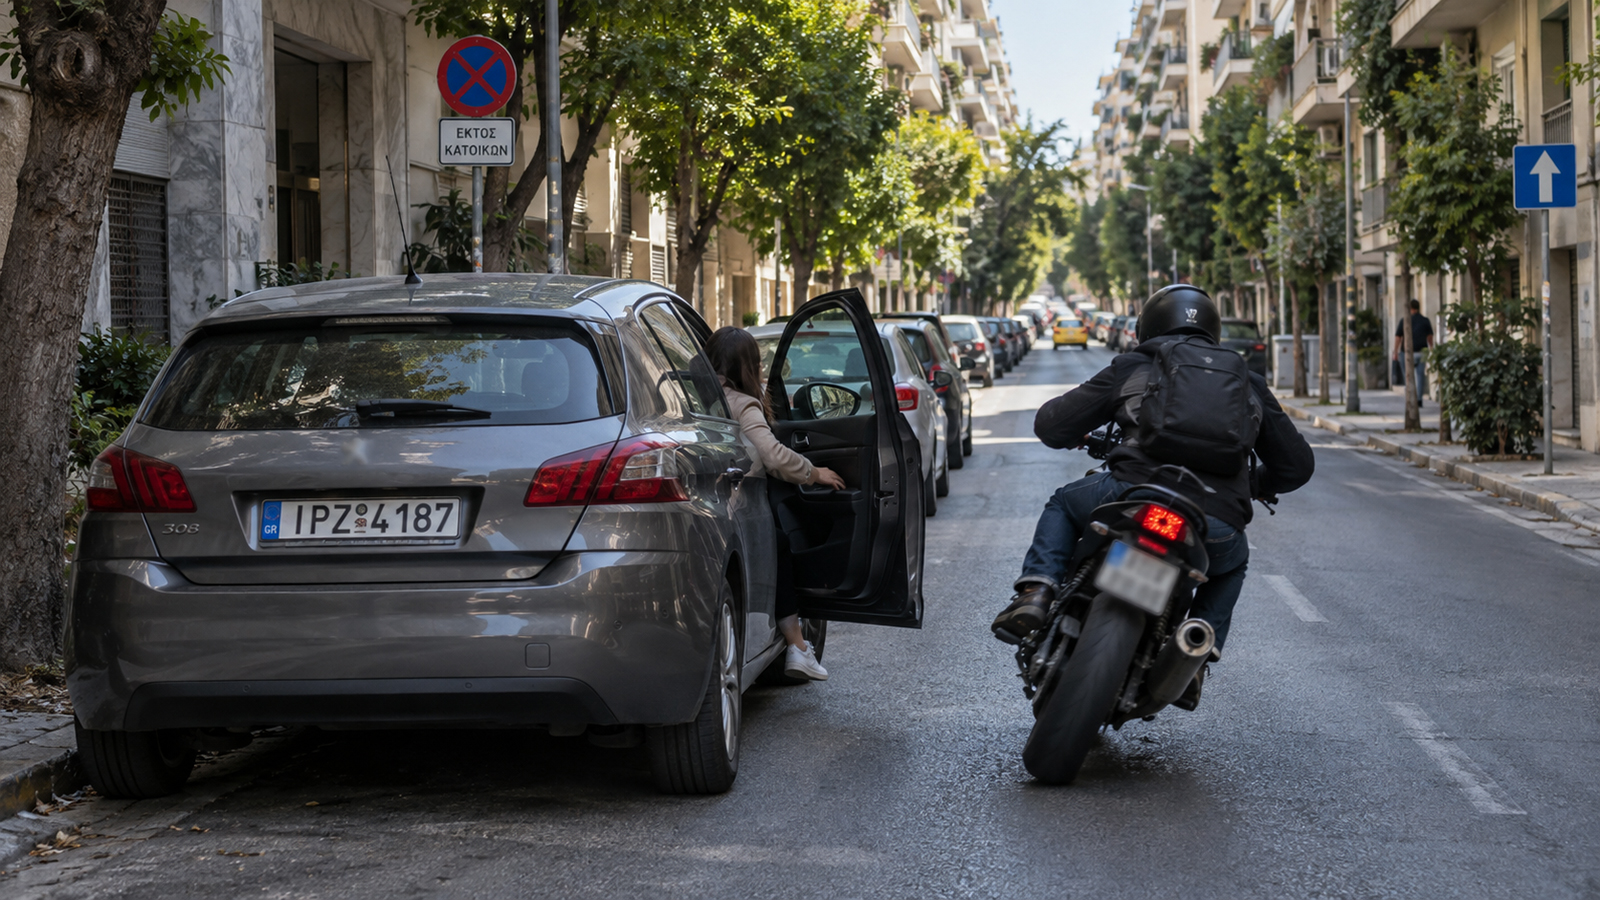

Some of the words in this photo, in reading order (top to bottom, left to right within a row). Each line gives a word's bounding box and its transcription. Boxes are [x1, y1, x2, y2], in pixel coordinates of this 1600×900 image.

[456, 127, 497, 139] ΕΚΤΟΣ
[444, 144, 508, 156] ΚΑΤΟΙΚΩΝ
[295, 504, 352, 535] IPZ
[370, 502, 454, 534] 4187
[162, 523, 200, 534] 308
[264, 524, 278, 534] GR
